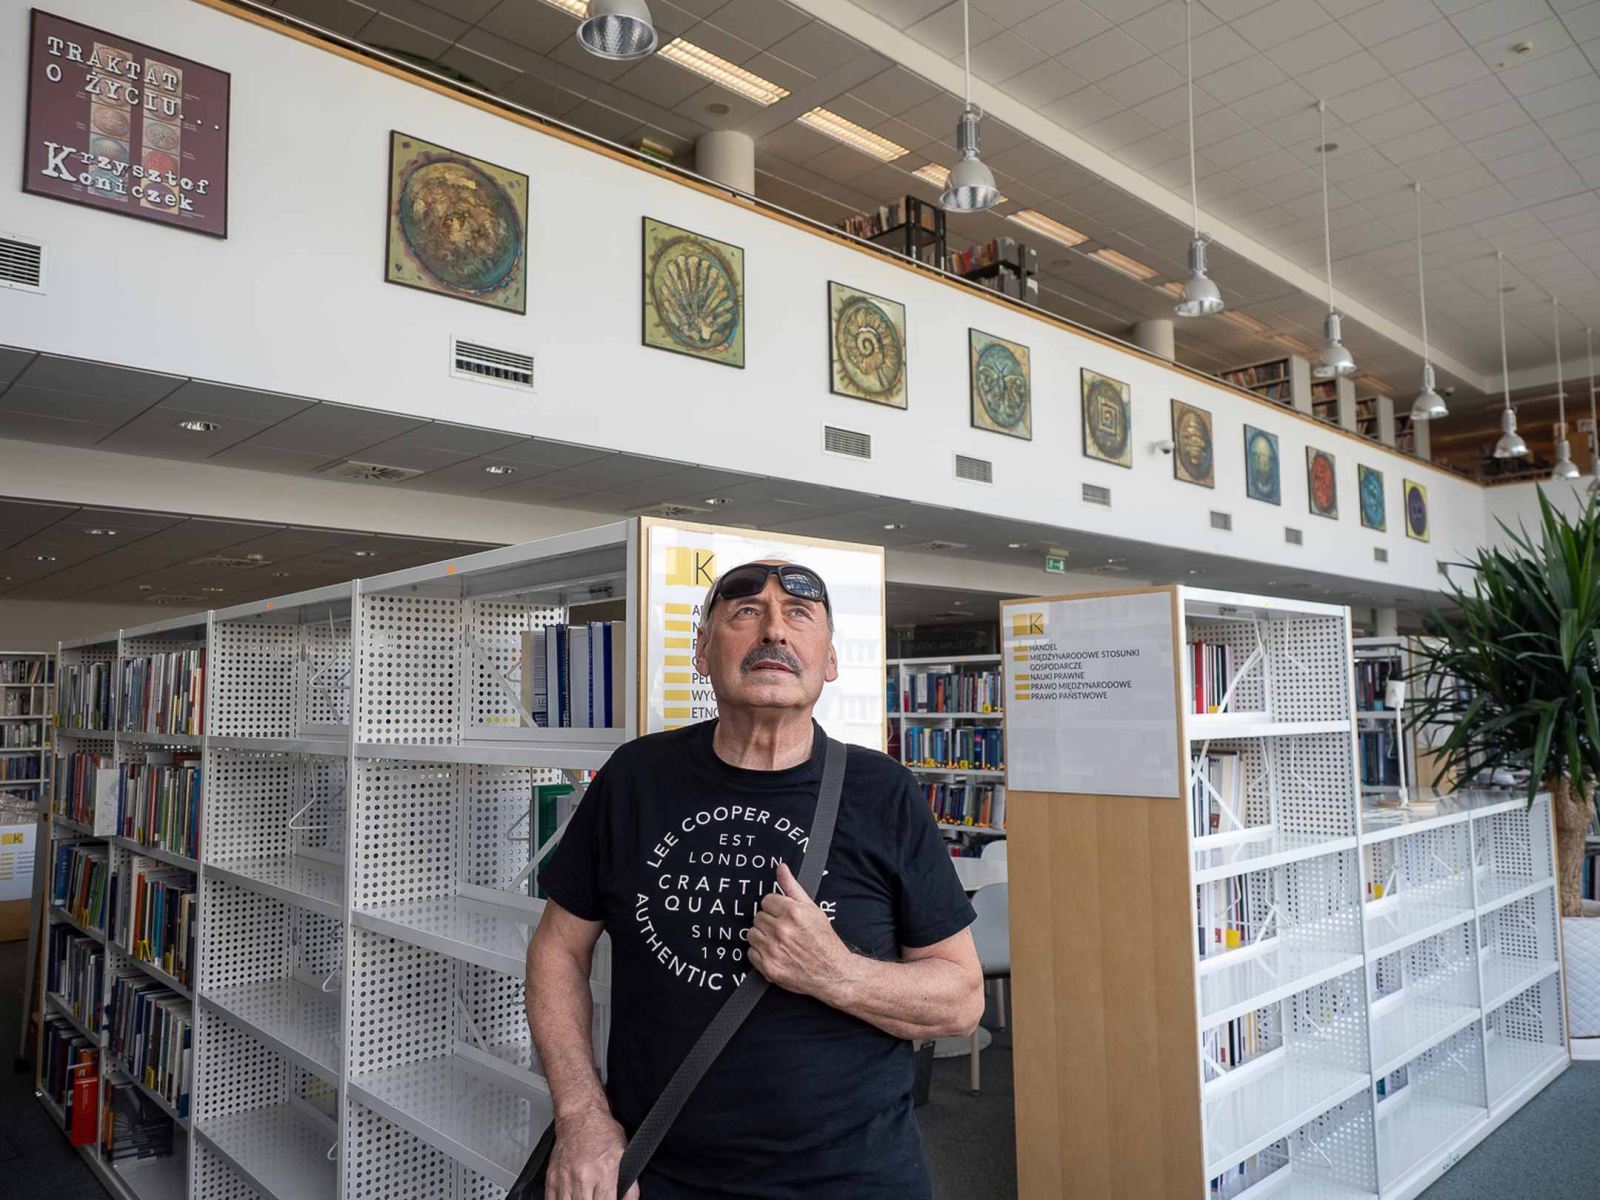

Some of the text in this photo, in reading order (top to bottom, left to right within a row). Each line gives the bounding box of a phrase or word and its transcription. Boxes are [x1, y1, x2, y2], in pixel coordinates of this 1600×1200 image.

[47, 36, 178, 91] TRAKTAT
[46, 64, 62, 82] O
[41, 141, 209, 194] Krzysztof
[696, 552, 715, 585] K
[1029, 613, 1044, 635] K
[1030, 643, 1058, 652] HANDEL
[1030, 649, 1140, 662] MIĘDZYNARODOWE STOSUNKI
[1030, 662, 1083, 671] GOSPODARCZE
[1030, 672, 1085, 681] NAUKI PRAWNE
[1031, 680, 1132, 691] PRAWO MIĘDZYNARODOWE
[1031, 690, 1108, 701] PRAWO PAŃSTWOWE
[647, 832, 679, 868] LEE
[681, 805, 770, 833] COOPER
[719, 833, 756, 847] EST
[689, 851, 783, 869] LONDON
[658, 874, 786, 897] CRAFTIN
[691, 924, 750, 941] SINC
[635, 893, 723, 990] AUTHENTIC
[701, 947, 743, 962] 190
